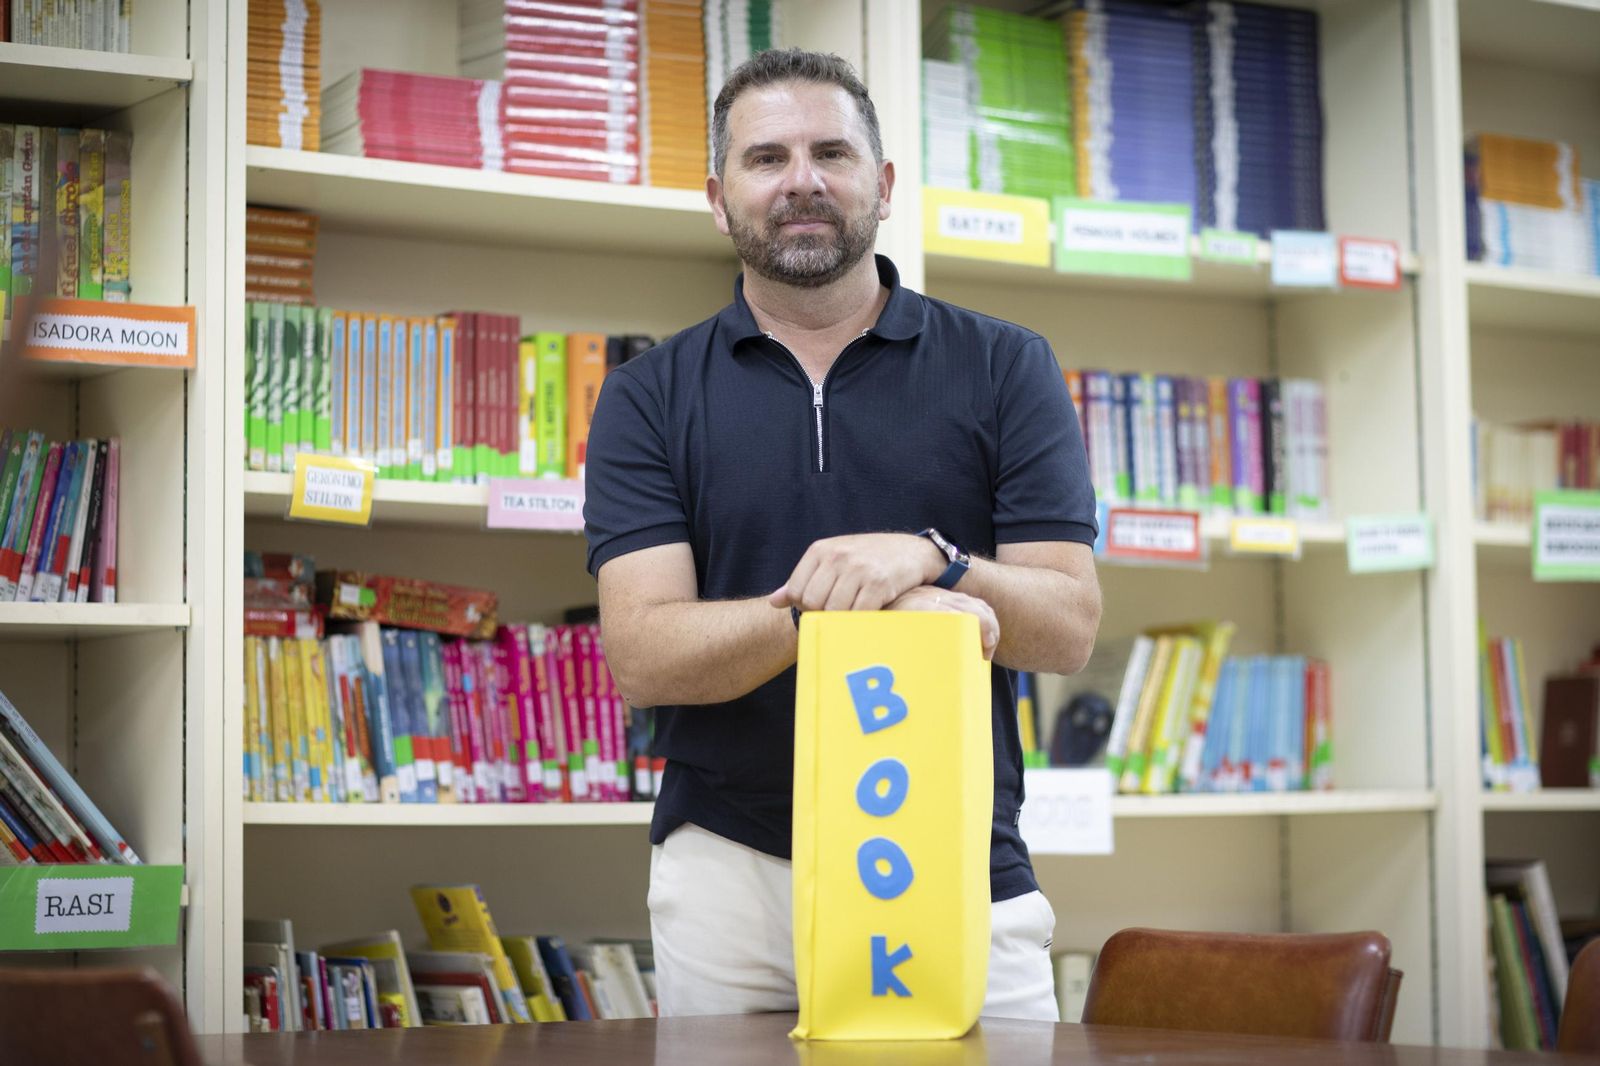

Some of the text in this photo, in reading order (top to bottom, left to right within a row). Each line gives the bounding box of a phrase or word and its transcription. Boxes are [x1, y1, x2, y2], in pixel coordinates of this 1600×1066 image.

[985, 217, 1016, 235] PAT
[33, 320, 178, 348] ISADORA MOON
[305, 489, 354, 507] STILTON
[504, 495, 576, 511] TEA STILTON
[845, 665, 914, 998] BOOK
[44, 893, 115, 918] RASI
